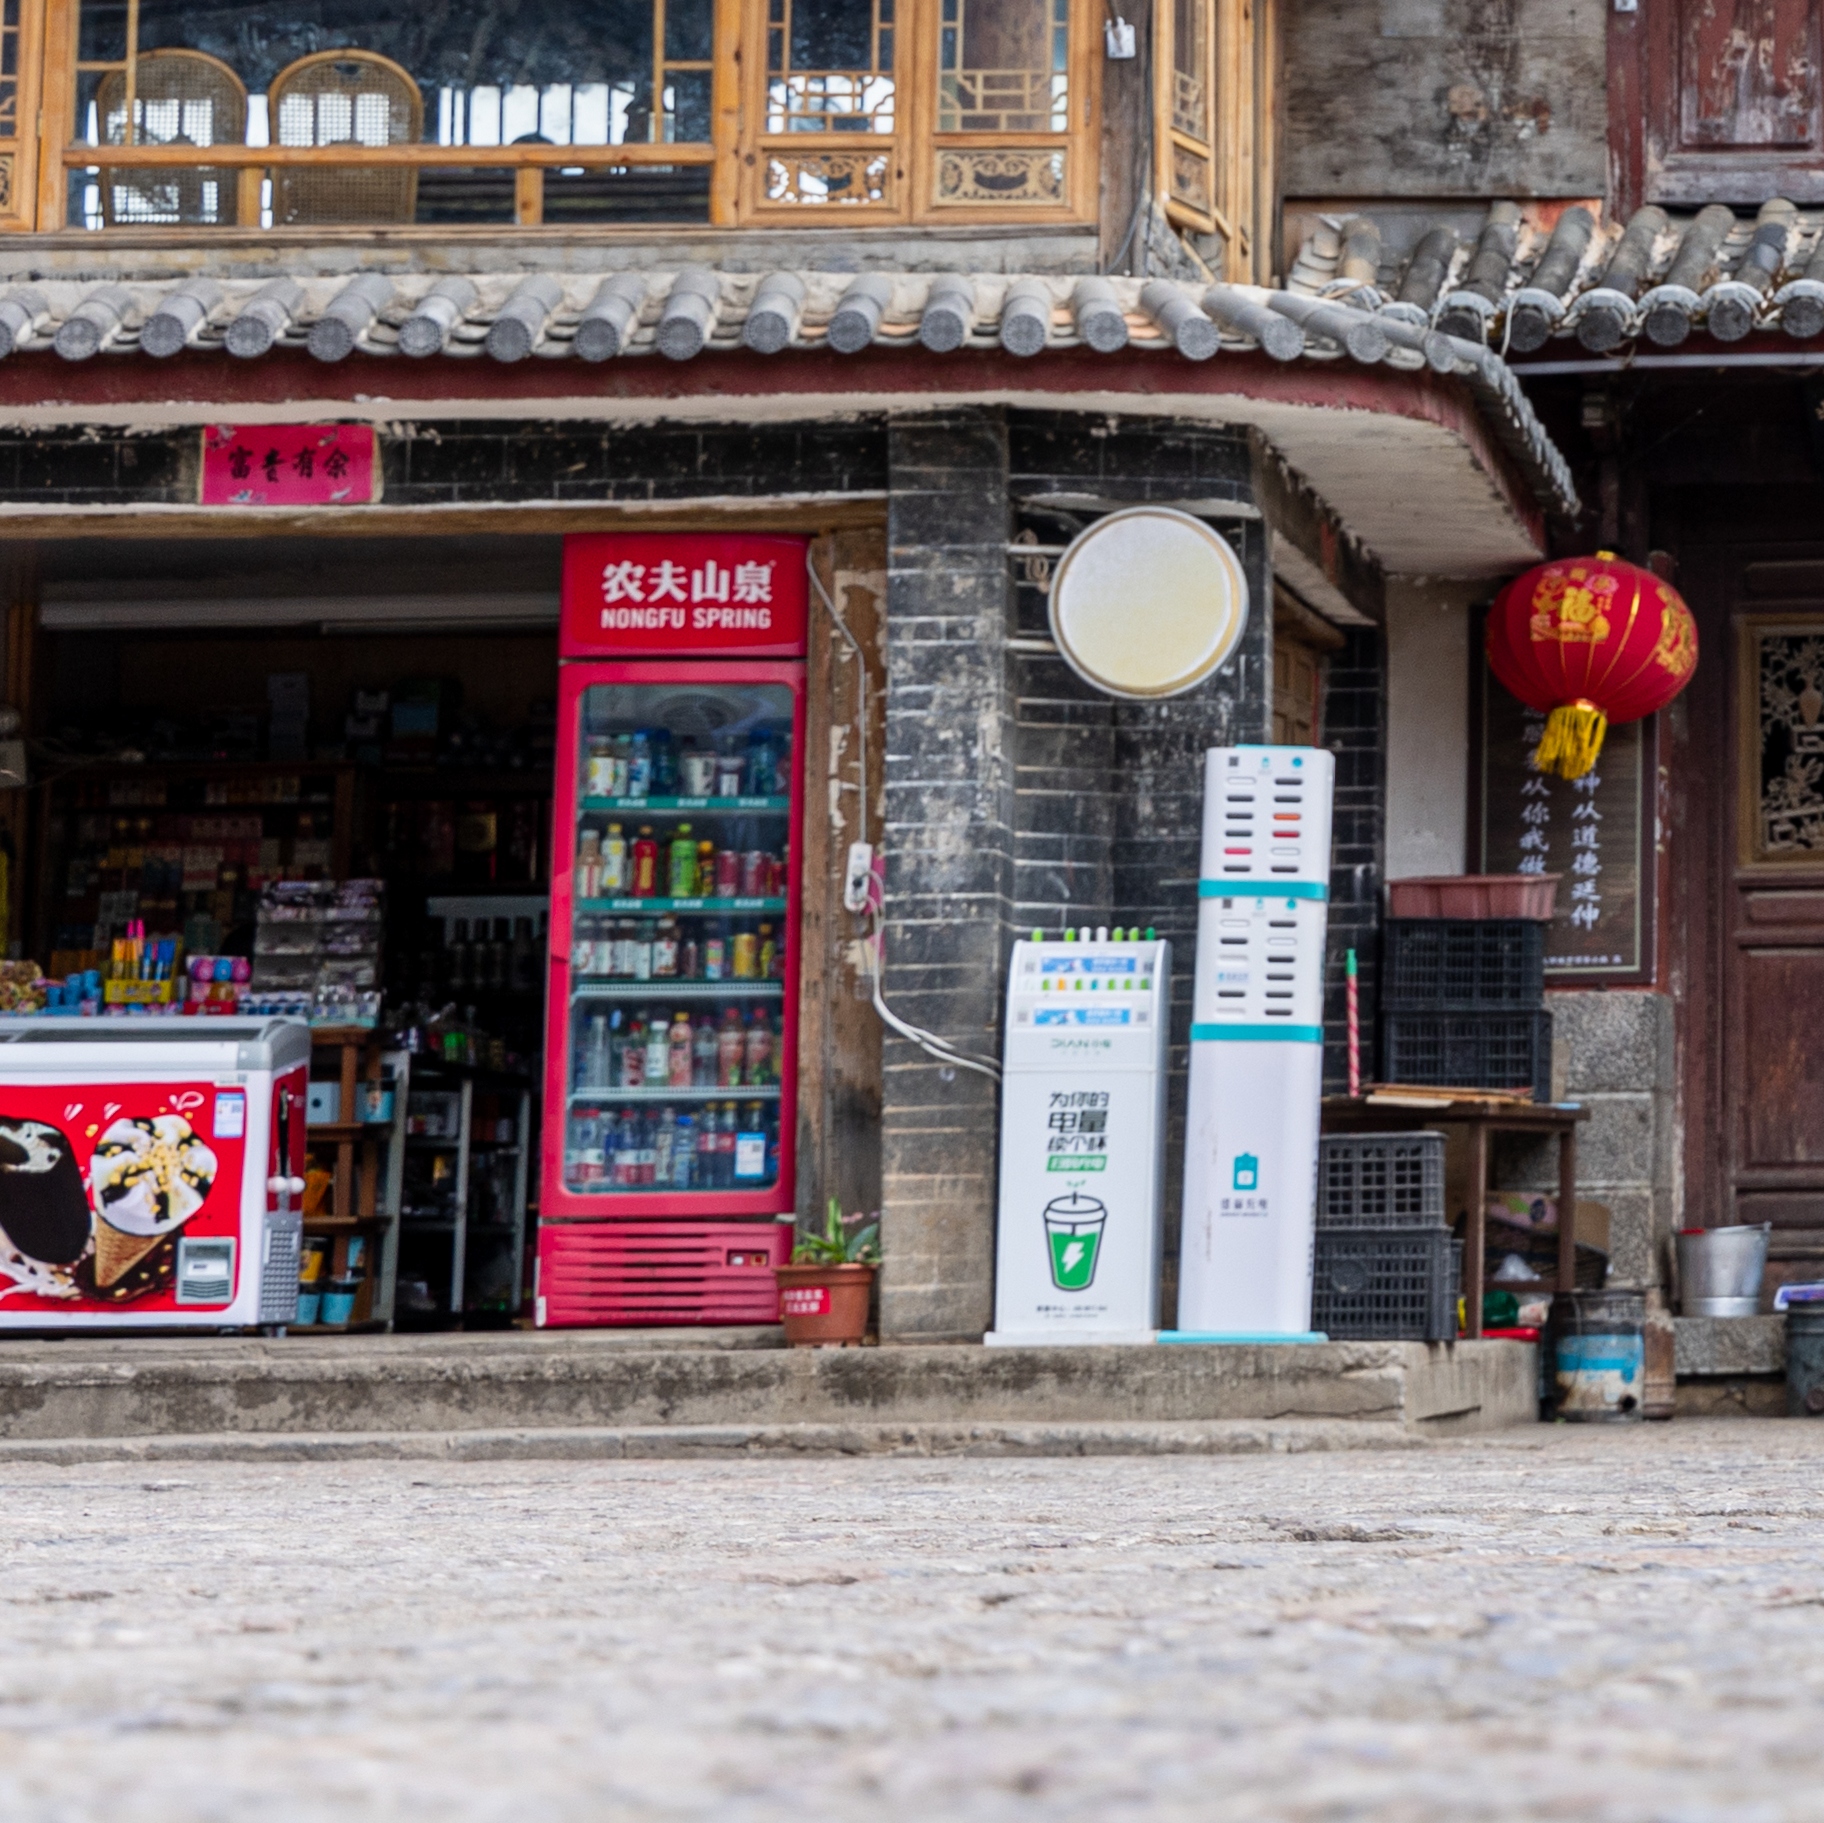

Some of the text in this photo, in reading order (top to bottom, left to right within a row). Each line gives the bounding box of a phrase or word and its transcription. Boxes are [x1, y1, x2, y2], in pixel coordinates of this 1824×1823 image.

[601, 559, 774, 604] 农夫山泉
[601, 607, 772, 630] NONGFU SPRING
[1048, 1109, 1109, 1134] 电量
